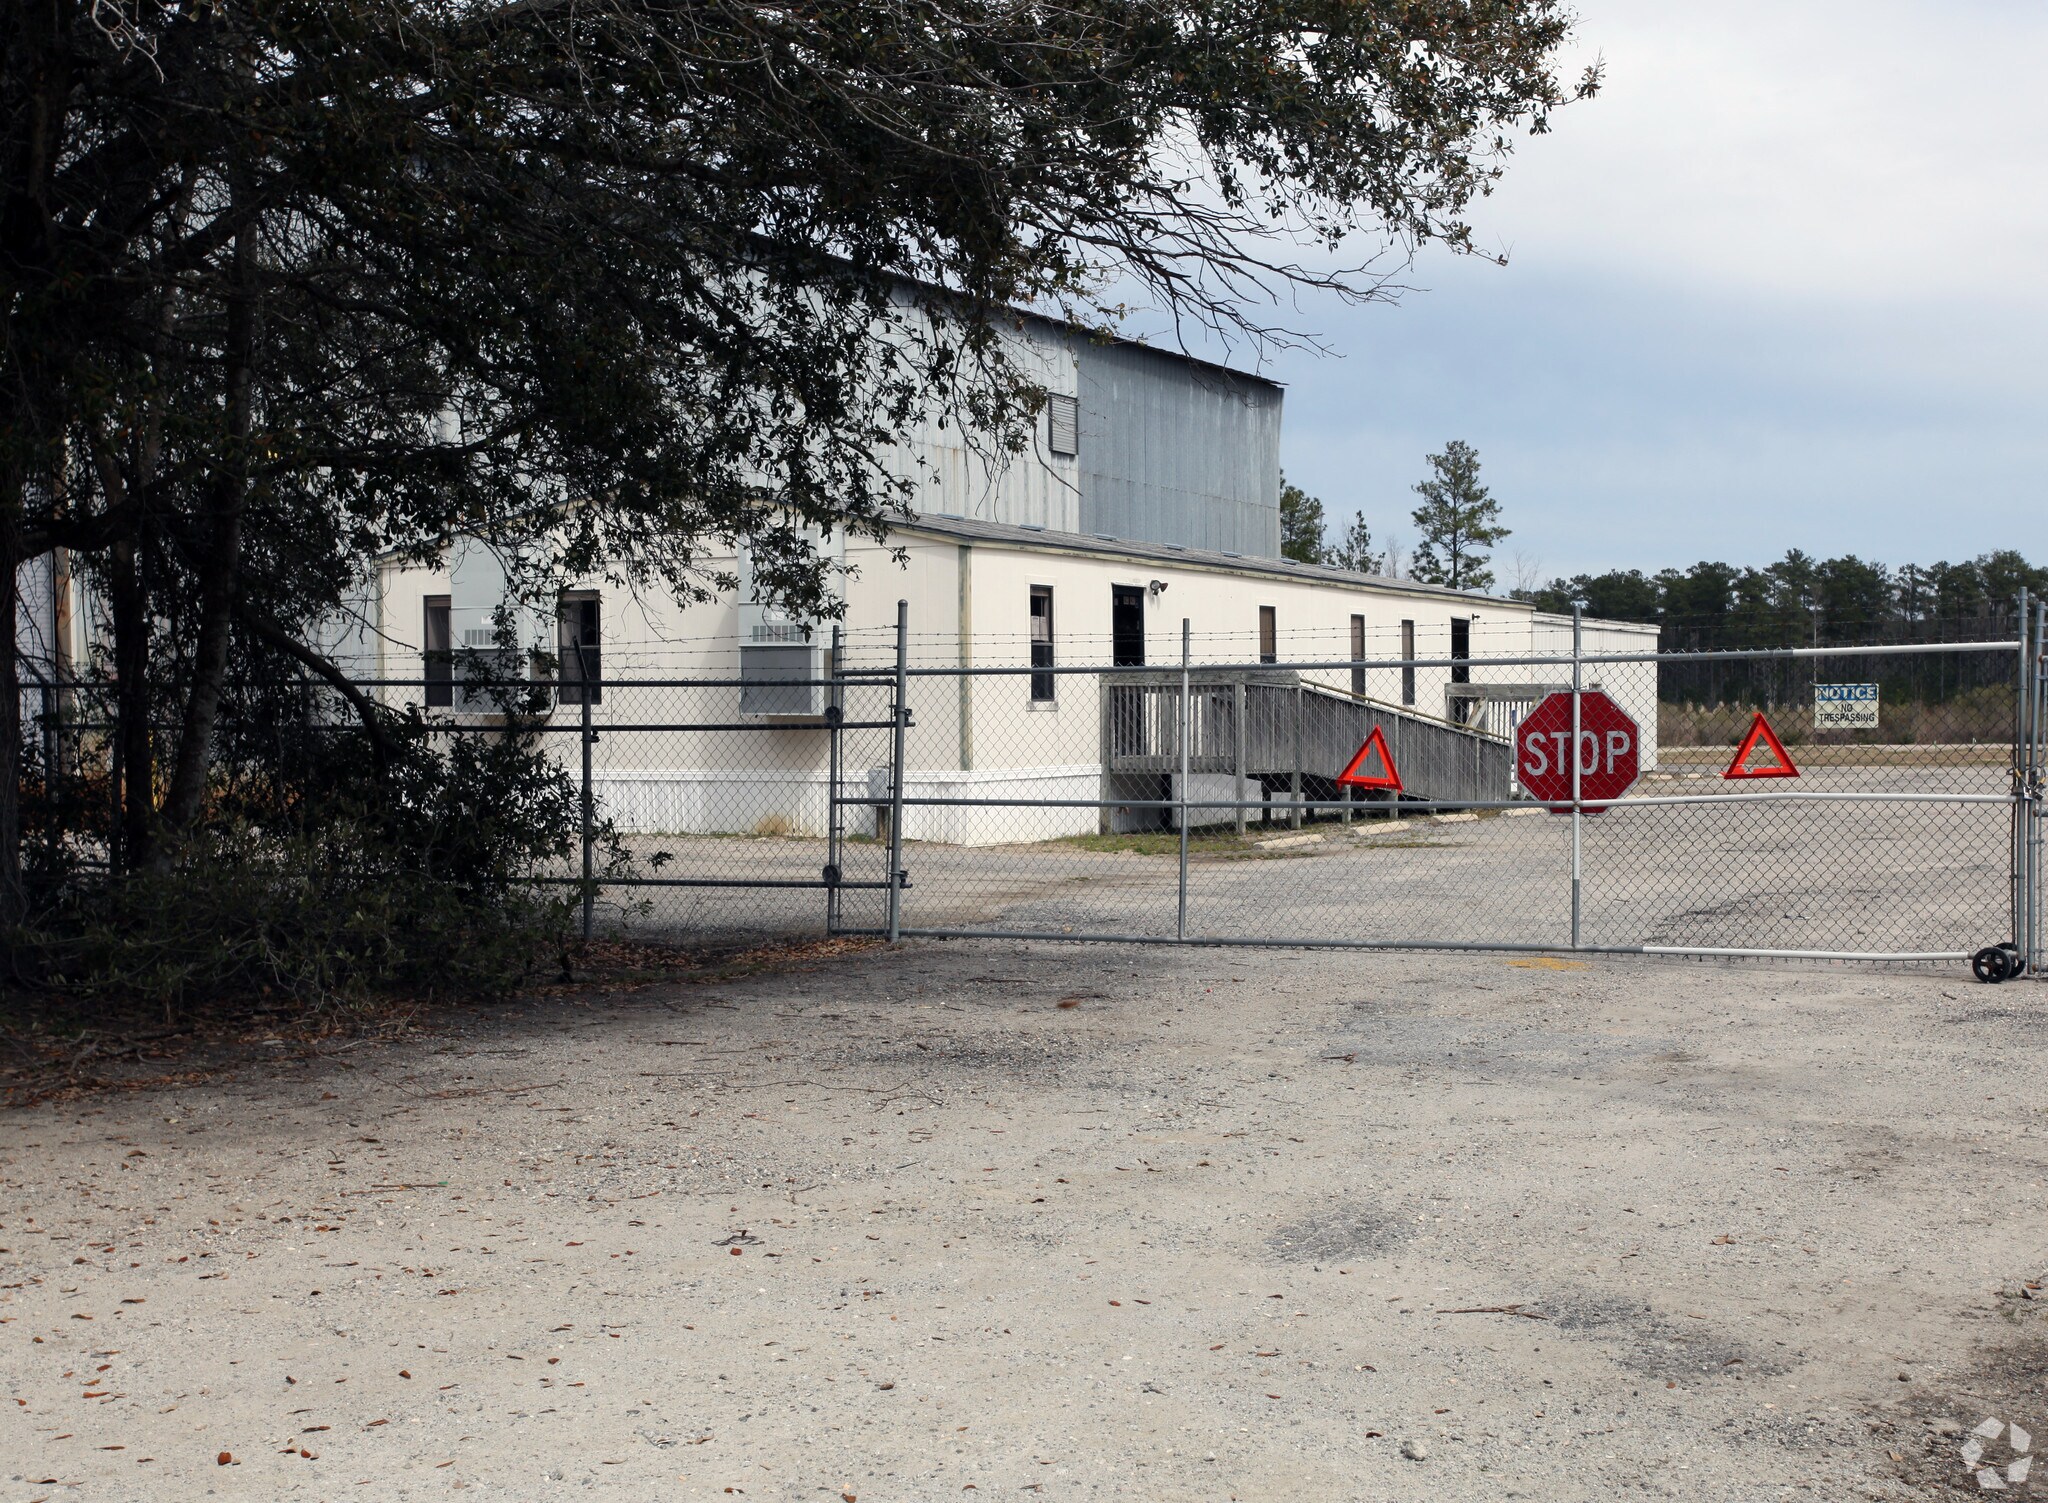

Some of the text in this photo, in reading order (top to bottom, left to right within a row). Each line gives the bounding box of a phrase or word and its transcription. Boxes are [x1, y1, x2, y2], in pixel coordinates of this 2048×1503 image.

[1817, 686, 1876, 699] NOTICE
[1841, 703, 1853, 712] NO
[1819, 713, 1875, 722] TRESPASSING
[1524, 730, 1630, 776] STOP
